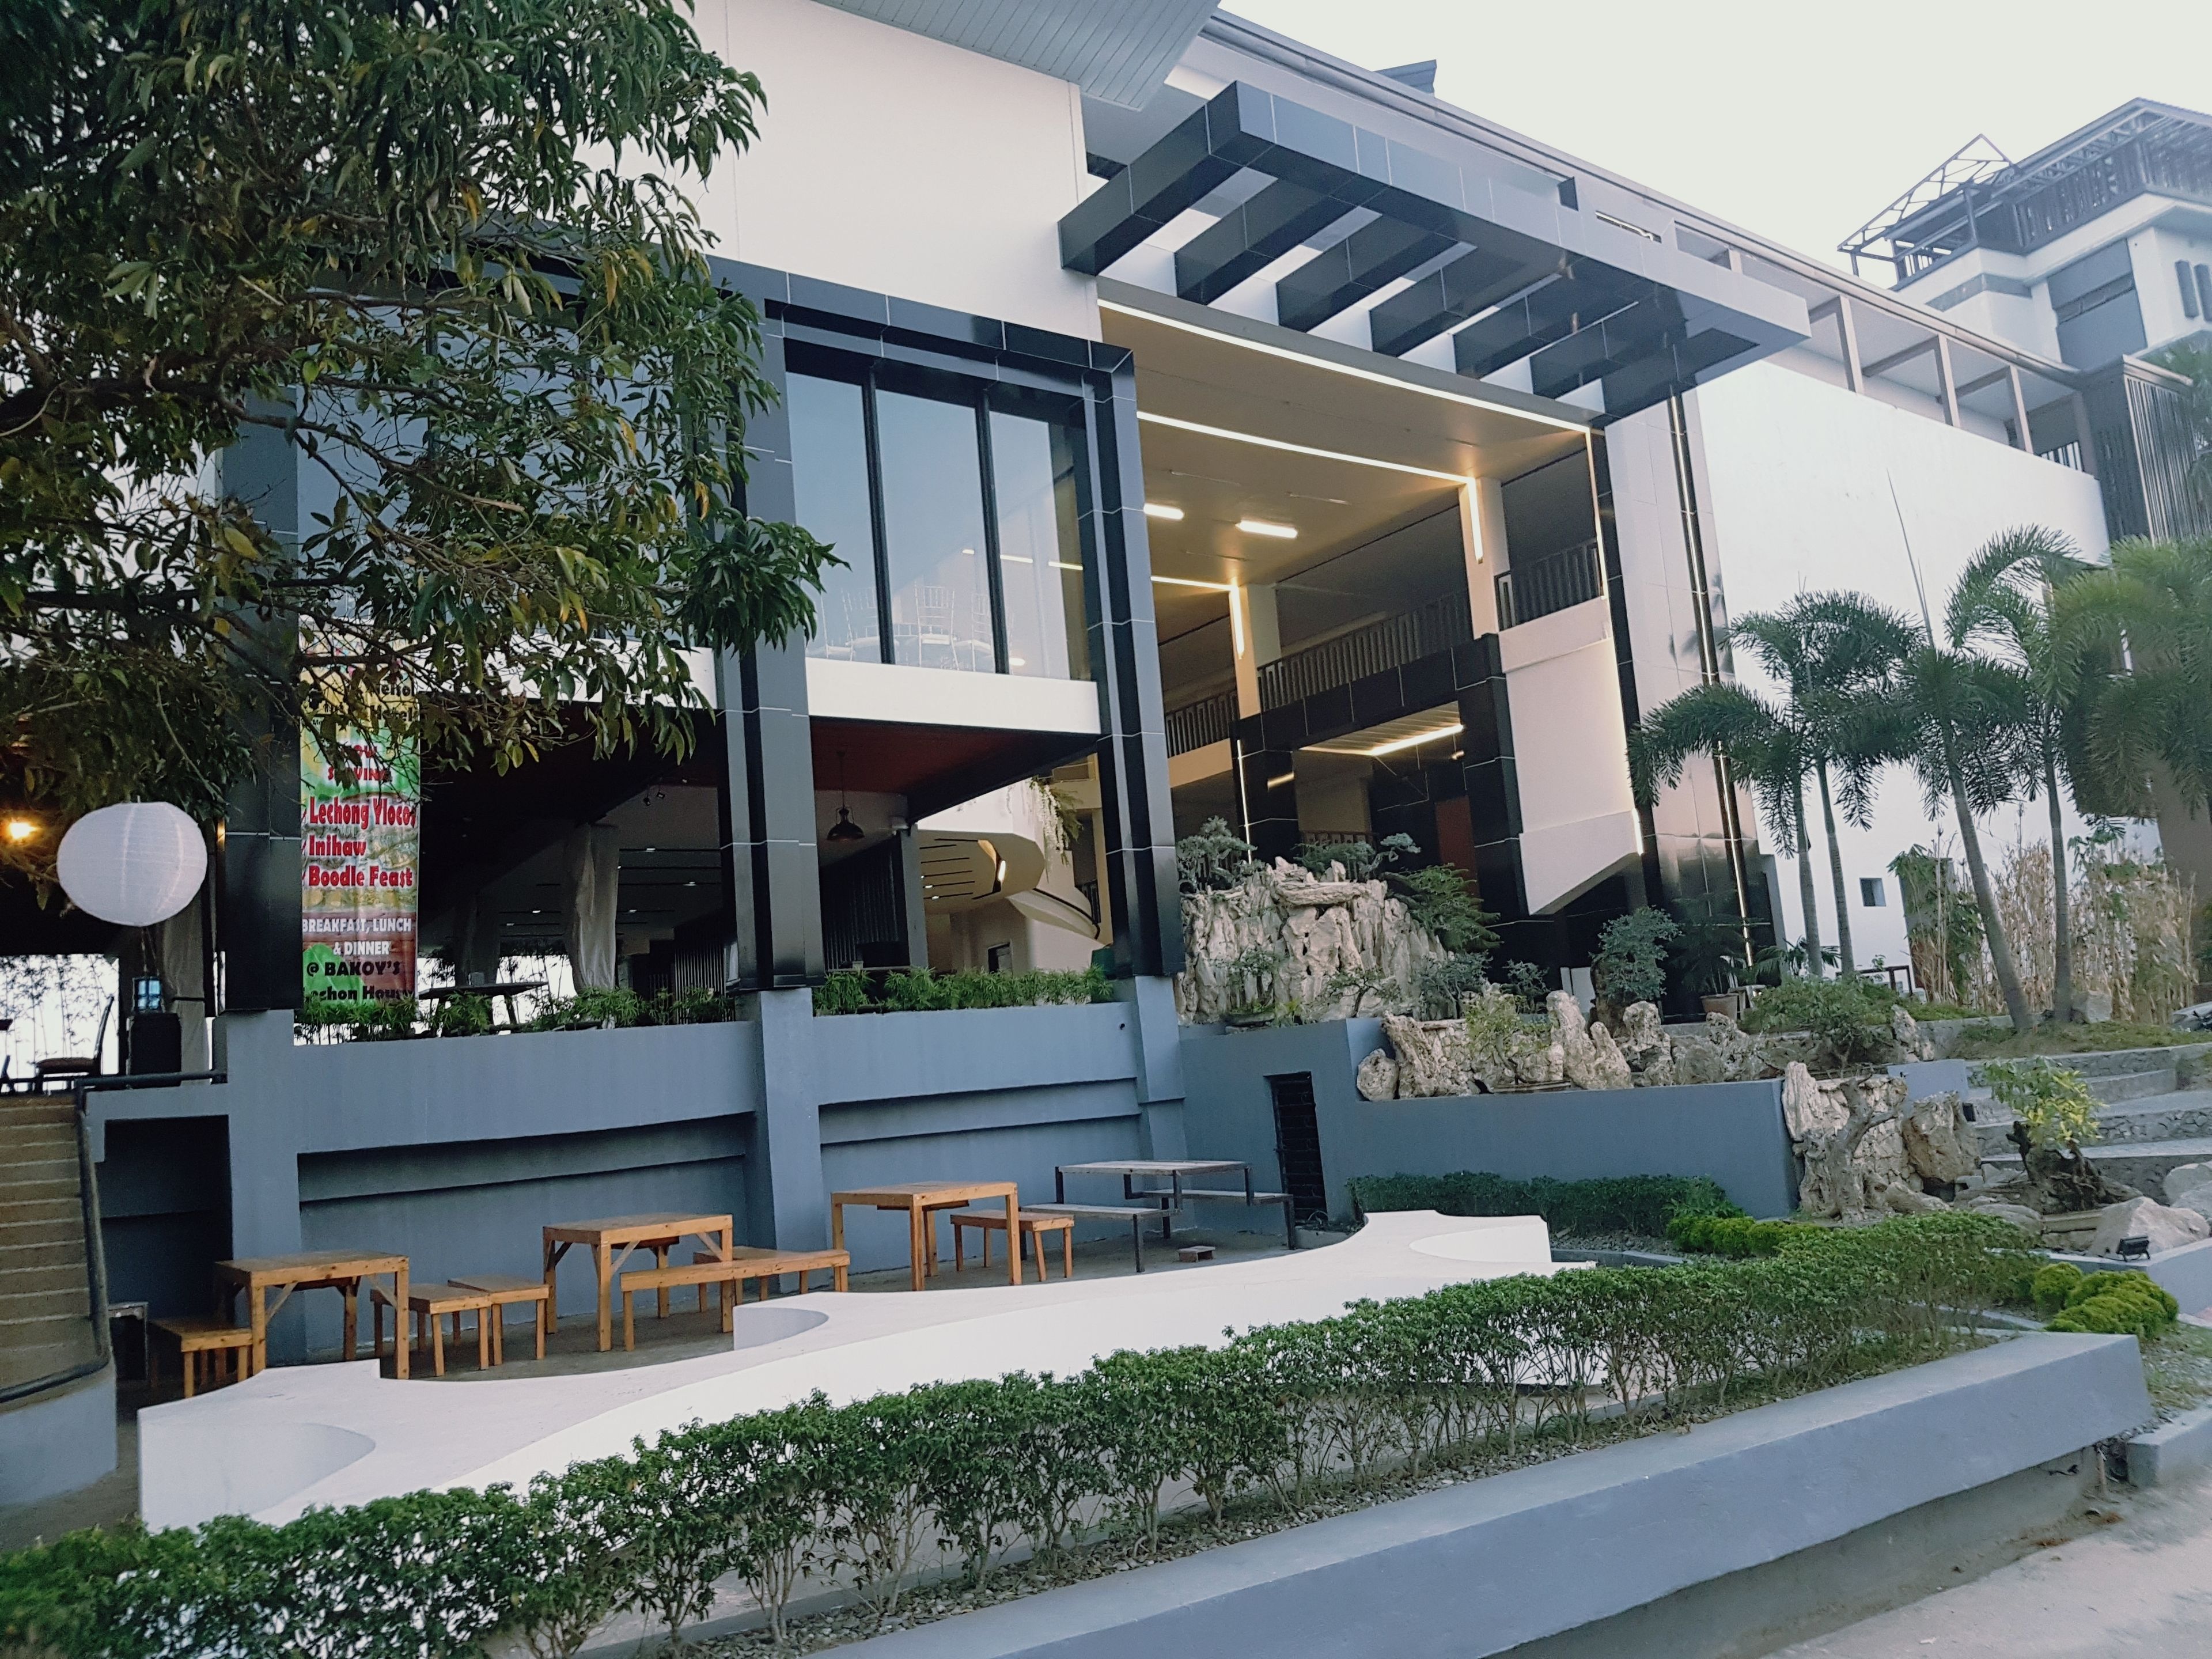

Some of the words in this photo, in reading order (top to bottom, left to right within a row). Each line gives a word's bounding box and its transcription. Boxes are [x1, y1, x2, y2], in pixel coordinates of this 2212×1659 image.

[370, 705, 412, 722] Hoel
[328, 767, 392, 781] SVIN
[310, 797, 369, 830] Lechong
[309, 835, 366, 855] Inihaw
[309, 865, 365, 887] Boodle
[369, 866, 412, 888] Feast
[302, 918, 369, 933] BREAKFAST,
[373, 918, 412, 931] LUNCH
[333, 941, 342, 955] &
[344, 941, 390, 955] DINNER
[306, 962, 319, 976] @
[324, 960, 402, 976] BAKOY'S
[303, 986, 358, 1001] echon
[362, 986, 415, 1000] Hous
